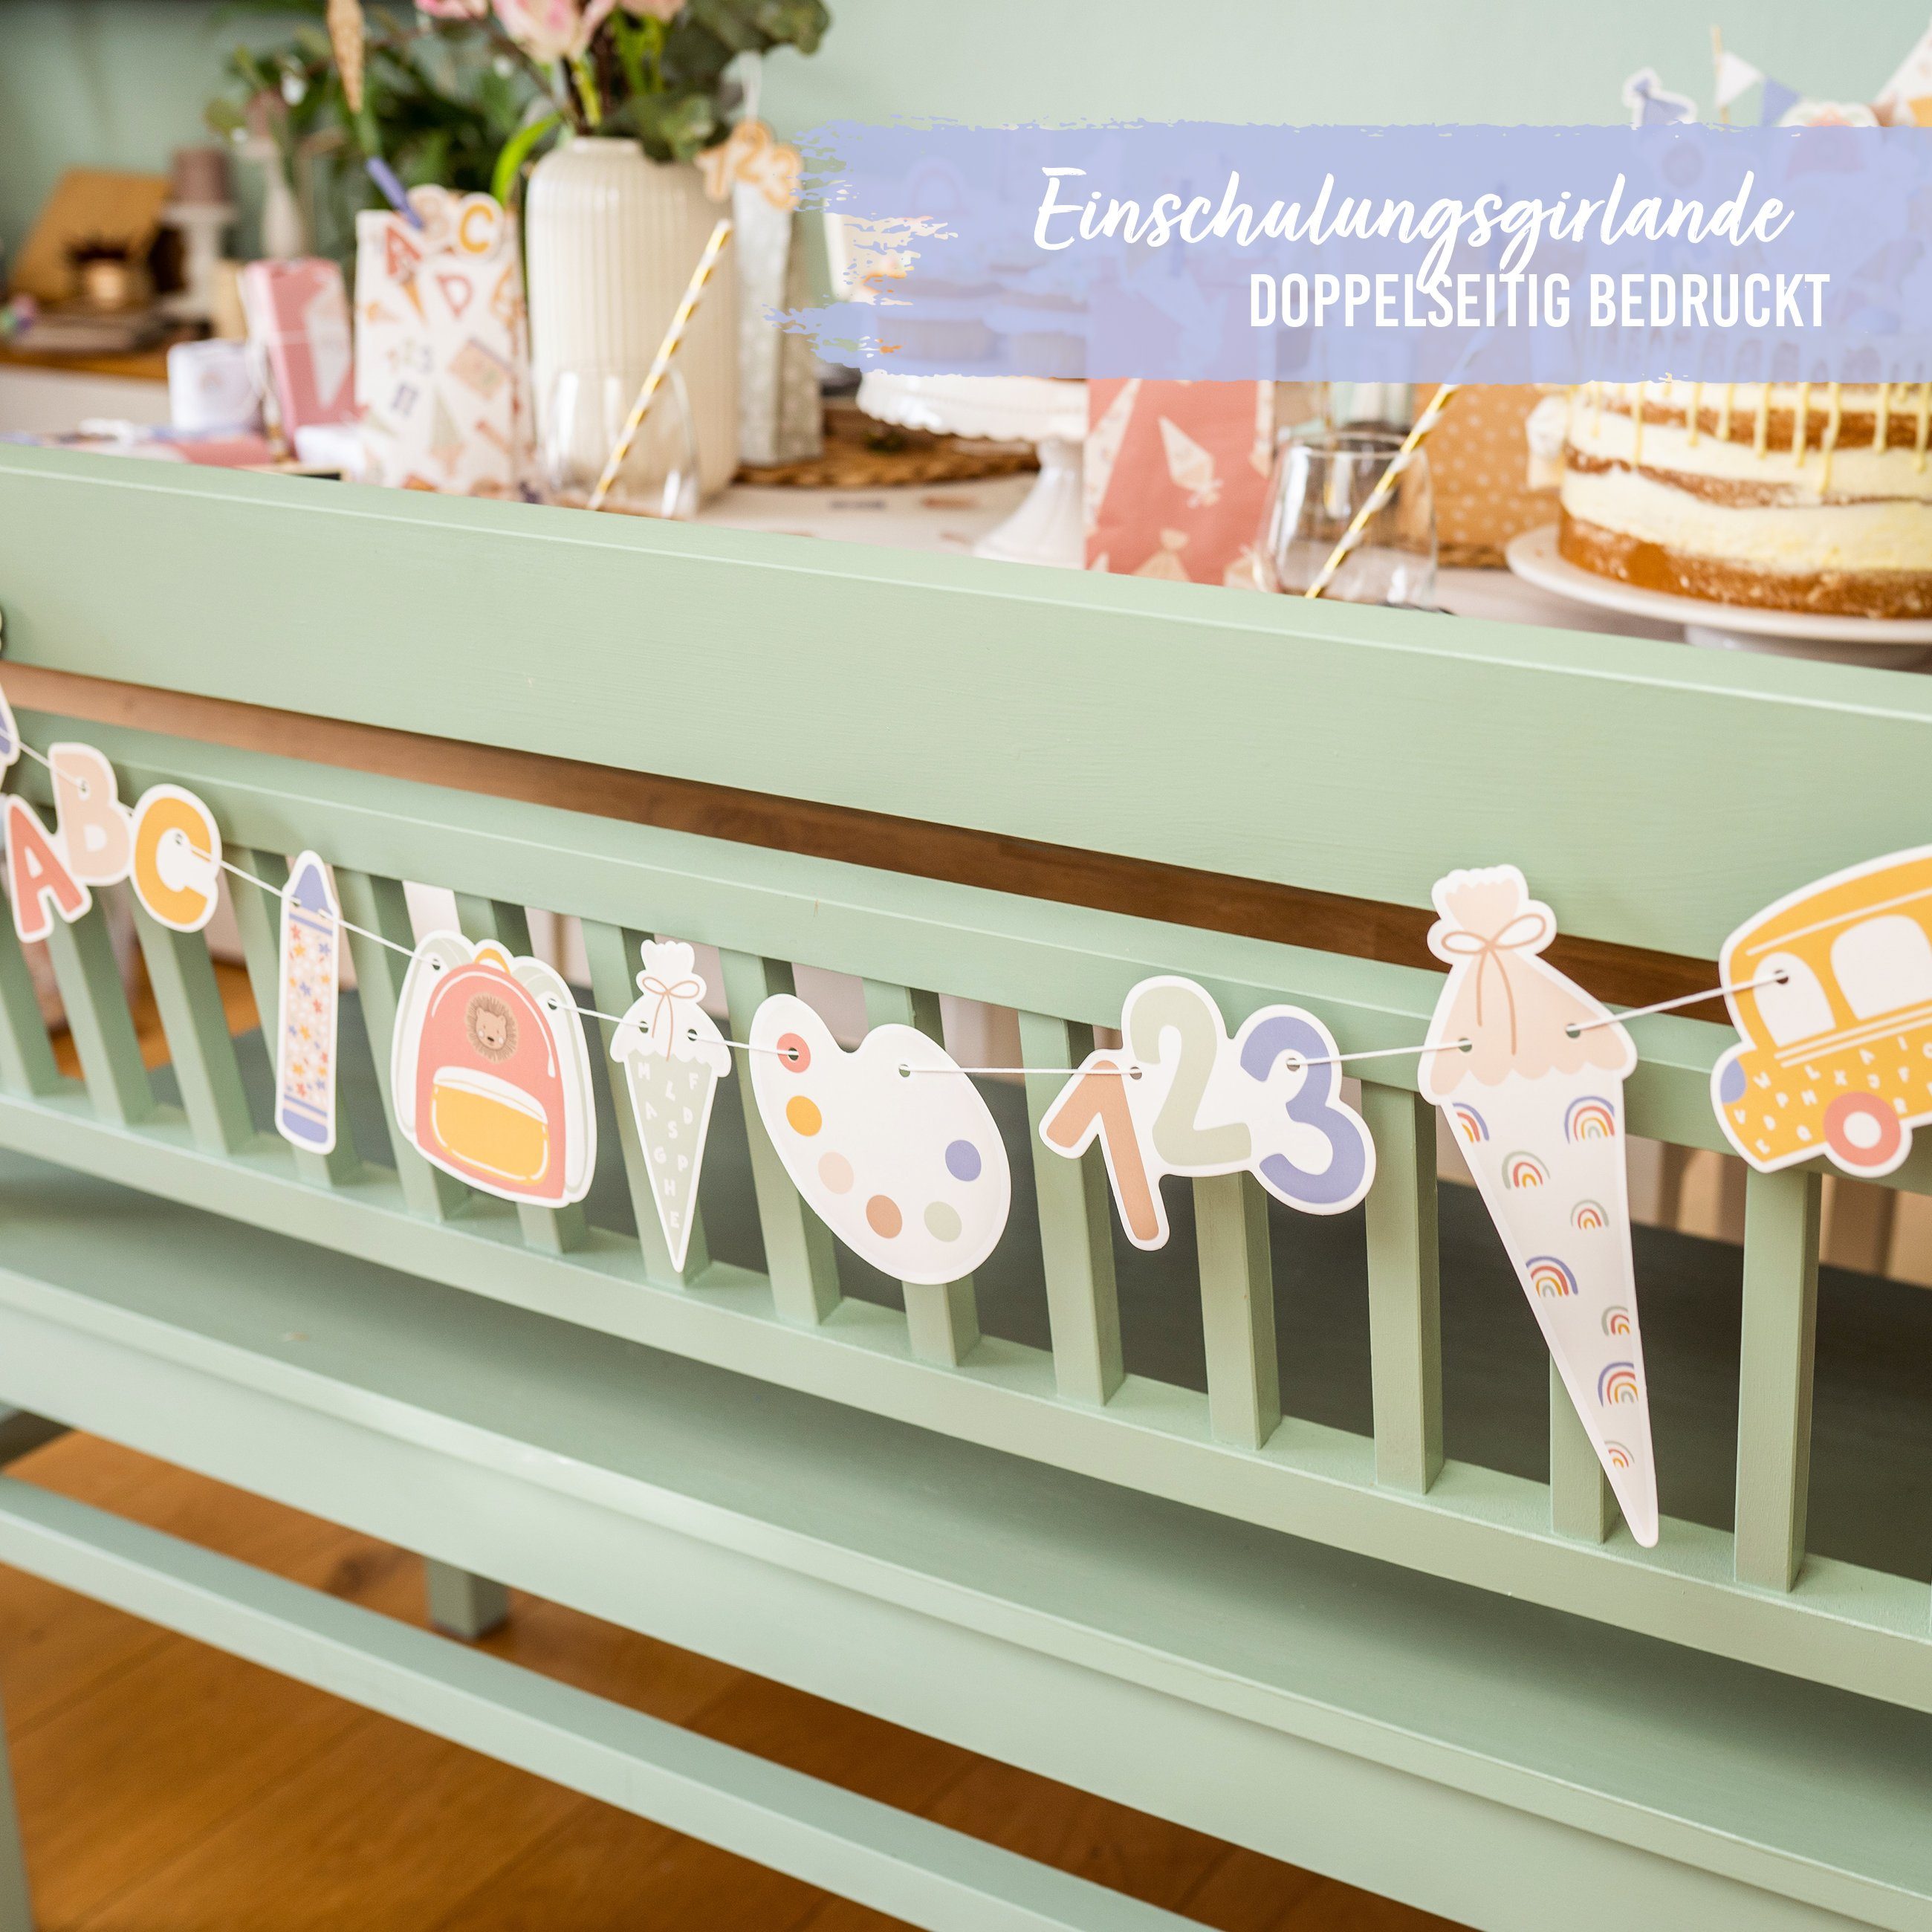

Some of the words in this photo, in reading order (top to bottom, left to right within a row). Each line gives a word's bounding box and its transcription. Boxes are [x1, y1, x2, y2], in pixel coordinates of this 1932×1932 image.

[10, 753, 212, 934] ABC
[638, 1062, 651, 1081] M
[689, 1072, 699, 1090] F
[665, 1080, 676, 1102] L
[645, 1100, 658, 1121] A
[1046, 985, 1365, 1241] 123
[667, 1121, 678, 1139] S
[664, 1178, 675, 1196] H
[670, 1210, 680, 1228] E
